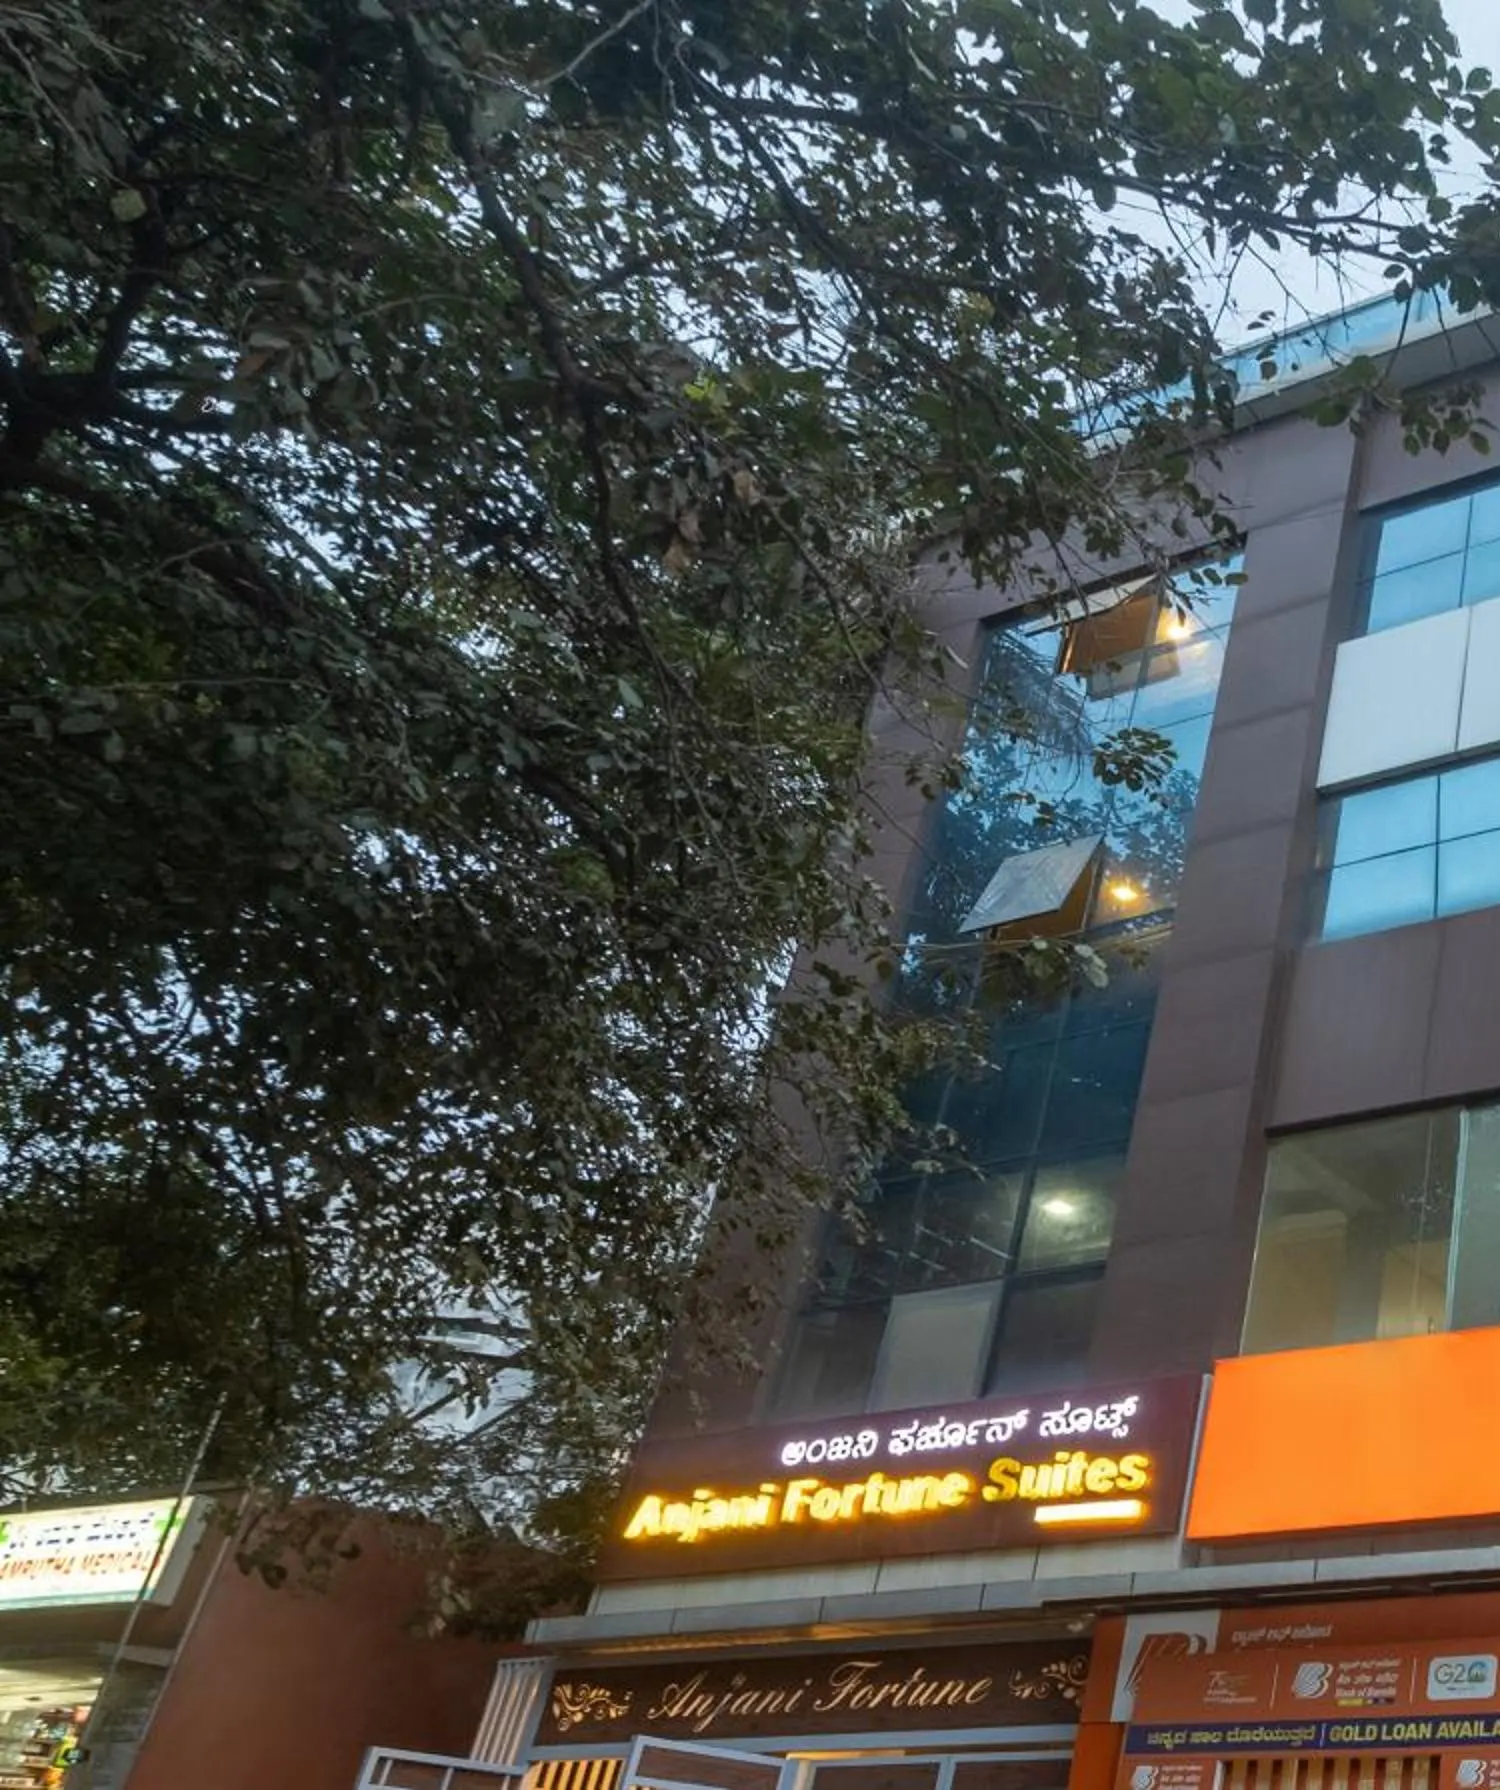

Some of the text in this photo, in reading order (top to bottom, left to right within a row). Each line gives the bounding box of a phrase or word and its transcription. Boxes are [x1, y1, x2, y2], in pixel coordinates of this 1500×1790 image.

[623, 1451, 1149, 1543] Anjani Fortune Suites
[647, 1661, 994, 1733] Anjani Fortune
[1329, 1723, 1377, 1742] GOLD
[1382, 1721, 1432, 1741] LOAN
